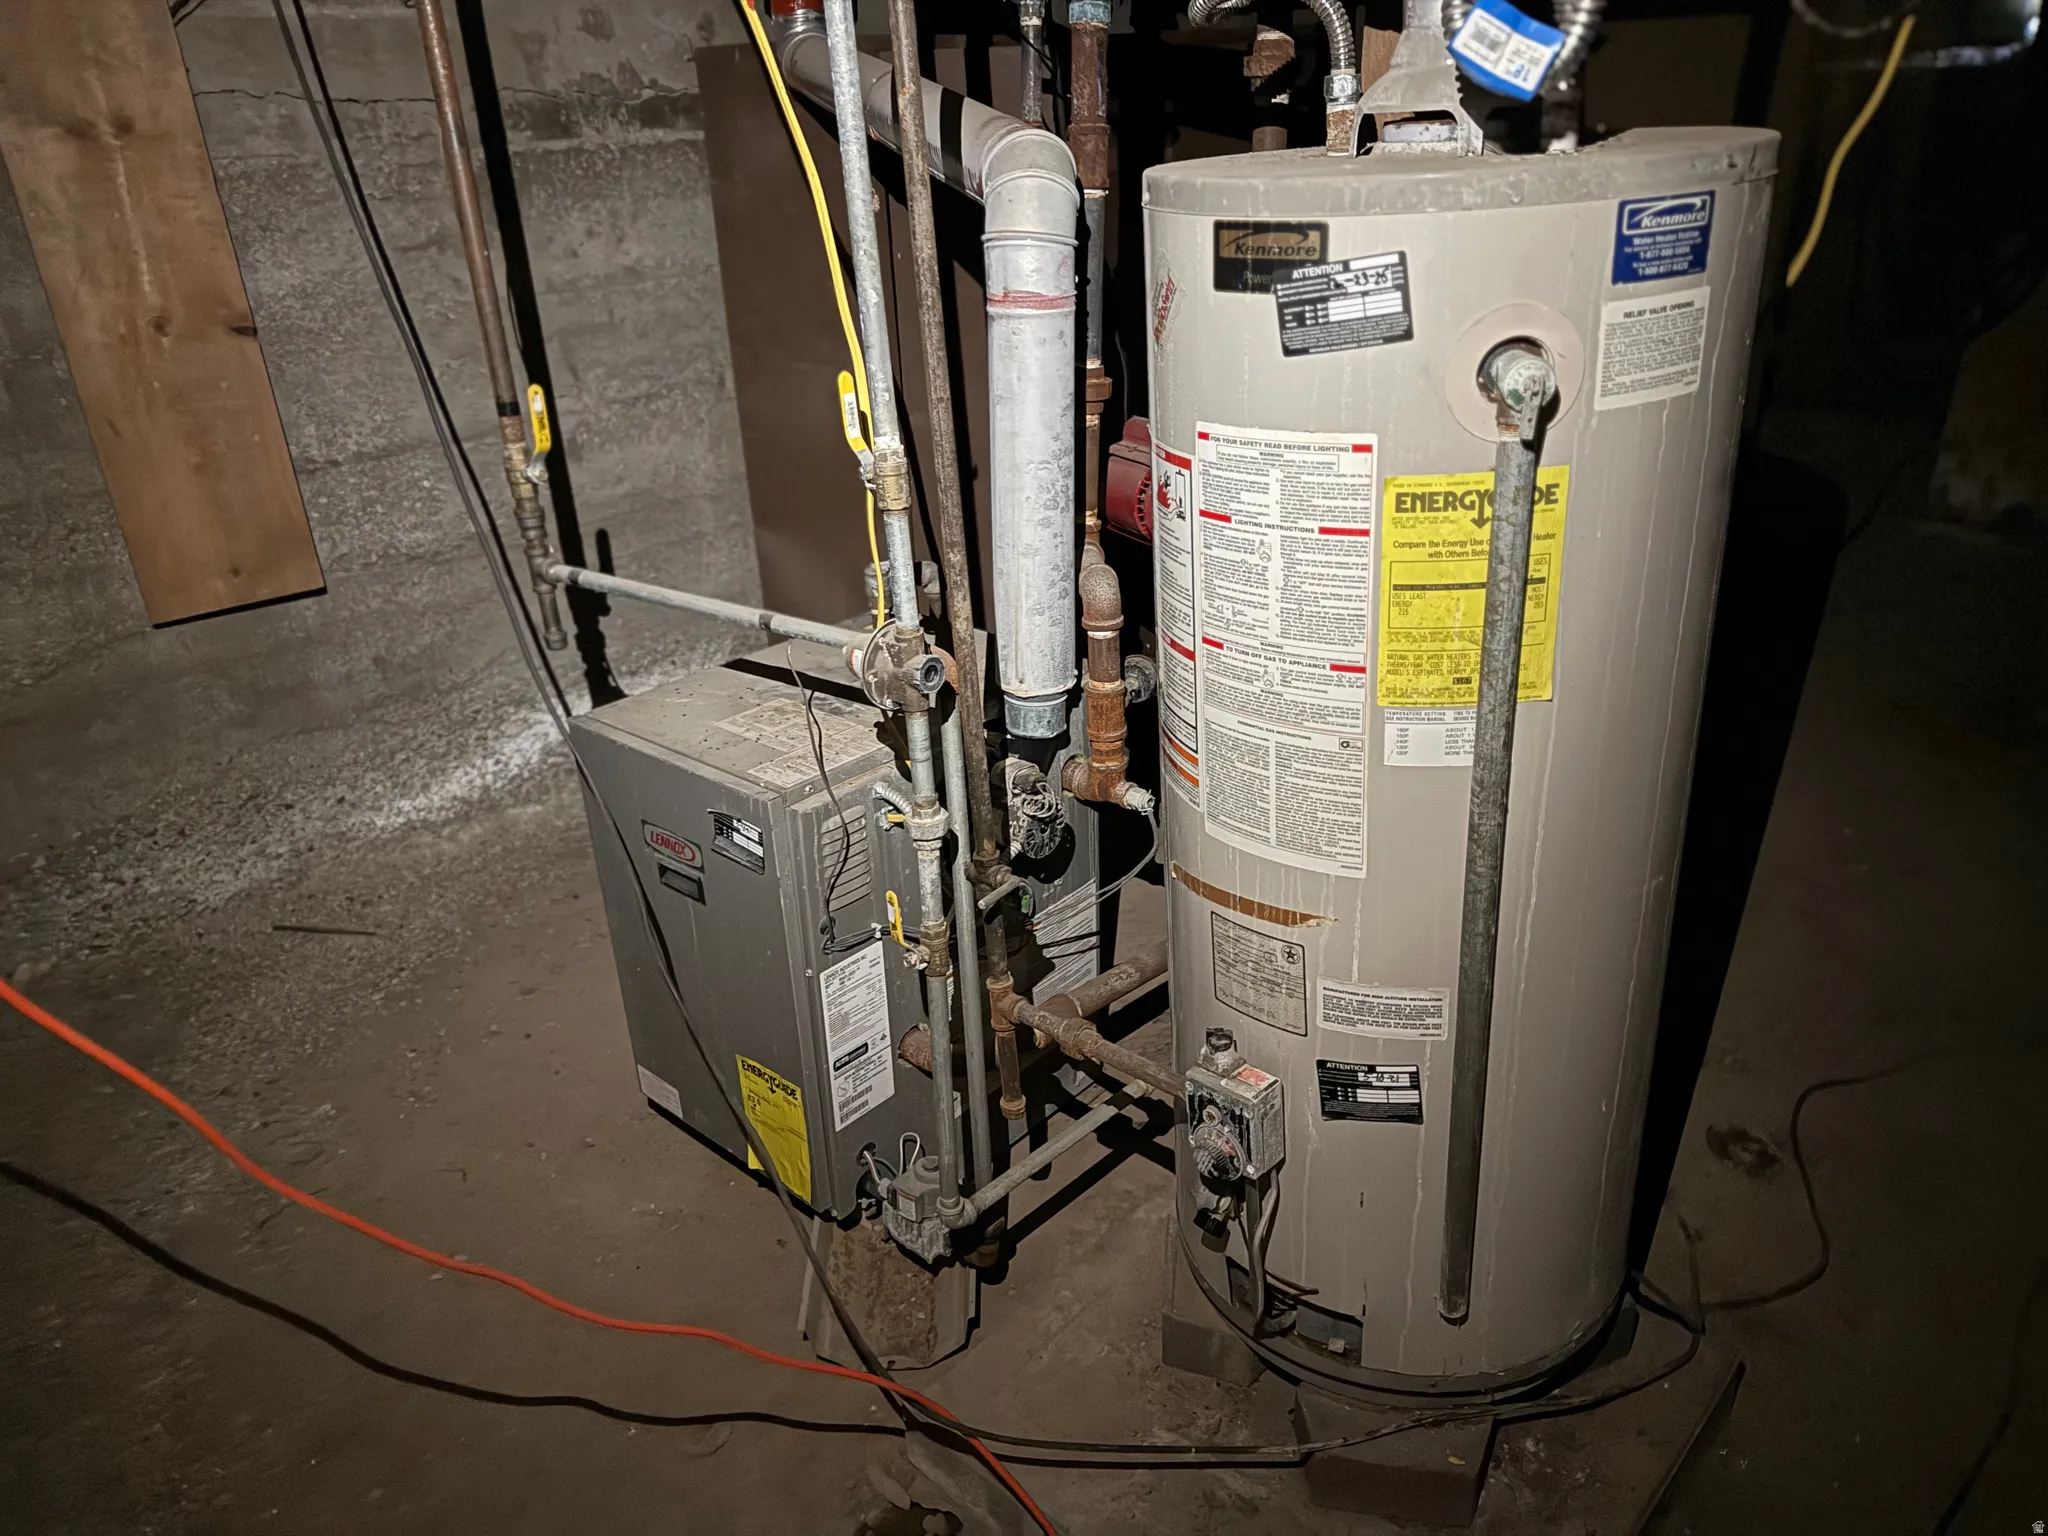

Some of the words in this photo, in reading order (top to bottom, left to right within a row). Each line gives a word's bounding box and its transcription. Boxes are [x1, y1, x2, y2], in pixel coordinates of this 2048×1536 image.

[1641, 211, 1706, 228] Kenmore
[1633, 237, 1654, 245] Water
[1234, 242, 1318, 257] Kenmore
[1292, 263, 1343, 280] ATTENTION
[1623, 309, 1647, 319] RELIEF
[1649, 305, 1668, 315] VALVE
[1669, 300, 1695, 311] OPENING
[1210, 435, 1221, 443] FOR
[1222, 437, 1238, 445] YOUR
[1239, 440, 1263, 449] SAFETY
[1264, 442, 1282, 450] READ
[1313, 445, 1350, 453] LIGHTING
[1234, 519, 1263, 528] LIGHTING
[1264, 522, 1315, 534] INSTRUCTIONS
[1533, 532, 1556, 540] Heater
[1393, 540, 1427, 550] Compare
[1428, 540, 1440, 548] the
[1441, 539, 1469, 549] Energy
[1469, 538, 1484, 546] Use
[1444, 550, 1469, 558] Others
[1471, 549, 1489, 557] Befo
[1392, 600, 1413, 608] ENERGY
[1234, 647, 1250, 656] TURN
[1263, 654, 1277, 662] GAS
[1288, 659, 1327, 671] APPLIANCE
[1387, 653, 1410, 661] NATURAL
[1447, 652, 1472, 660] HEATERS
[1275, 730, 1312, 740] INSTRUCTIONS
[650, 830, 687, 858] LENNOX
[1326, 1062, 1368, 1072] ATTENTION
[741, 1060, 798, 1100] ENERGYGUIDE
